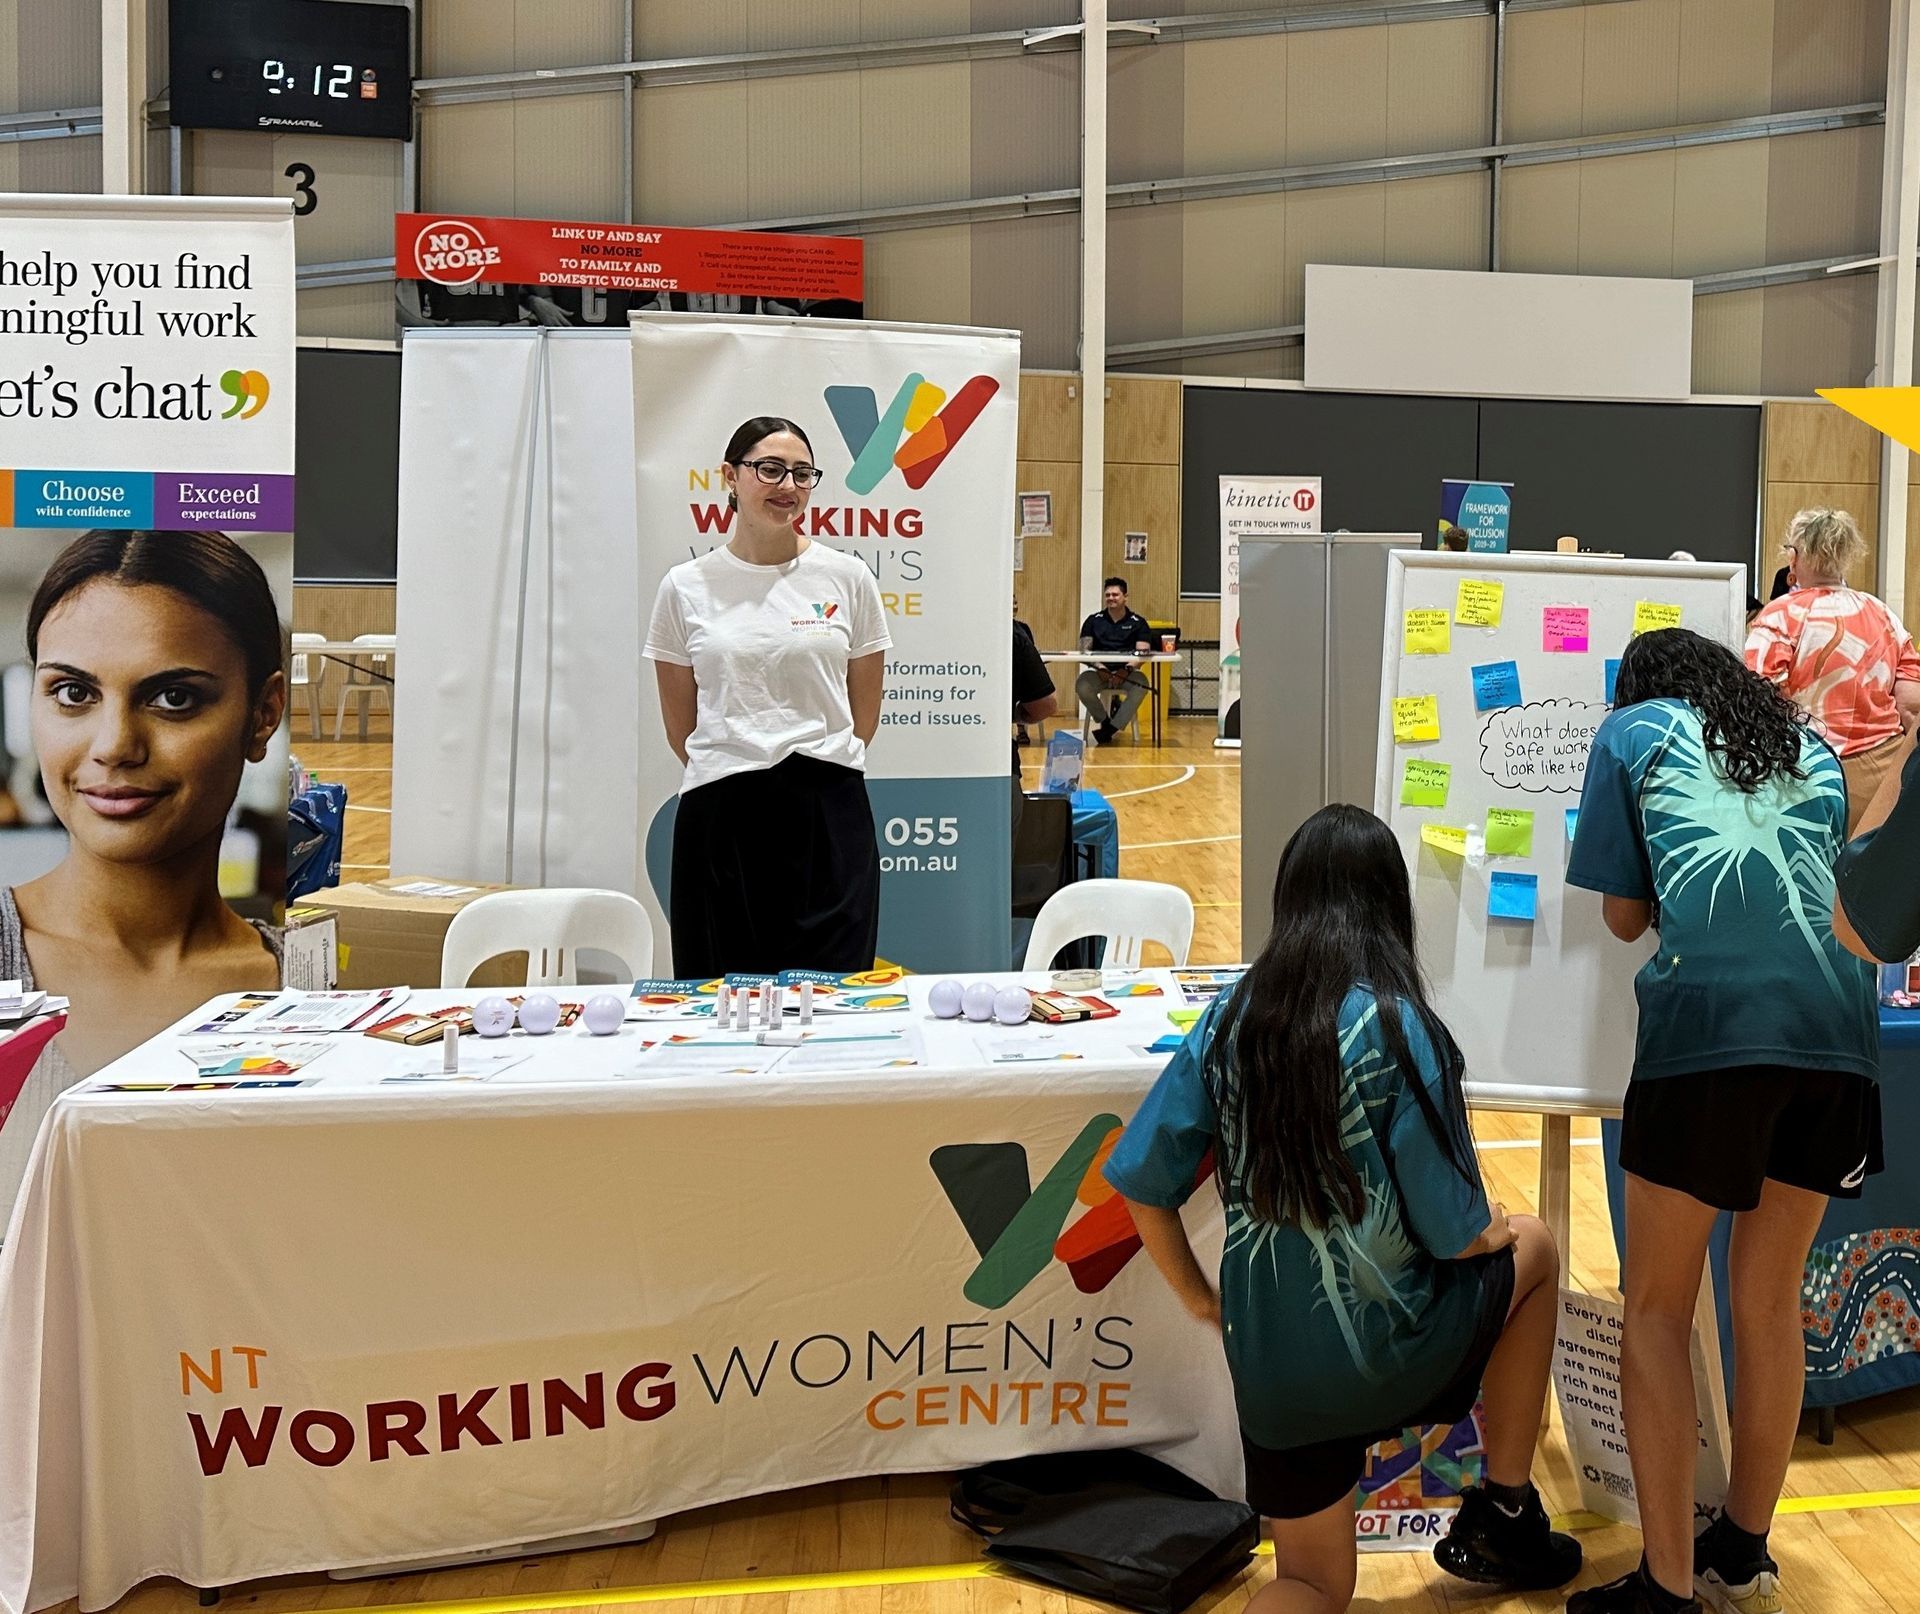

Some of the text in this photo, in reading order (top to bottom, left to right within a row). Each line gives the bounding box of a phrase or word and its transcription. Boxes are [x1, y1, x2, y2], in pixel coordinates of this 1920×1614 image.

[258, 116, 323, 127] STRAMATEL
[284, 162, 318, 216] 3
[428, 233, 469, 251] NO
[552, 227, 662, 243] LINK UP AND SAY
[423, 247, 501, 271] MORE
[580, 244, 642, 257] NO MORE
[0, 250, 252, 297] help you find
[560, 258, 661, 274] TO FAMILY AND
[539, 273, 678, 289] DOMESTIC VIOLENCE
[0, 299, 258, 345] ningful work
[0, 364, 212, 421] et's chat
[42, 480, 125, 502] Choose
[178, 482, 261, 504] Exceed
[1226, 488, 1311, 509] kinetic IT
[36, 506, 131, 518] with confidence
[181, 509, 256, 521] expectations
[1465, 503, 1508, 515] FRAMEWORK
[690, 503, 923, 538] WRKING
[1228, 520, 1242, 528] GET
[1243, 520, 1252, 528] IN
[1280, 521, 1299, 529] WITH
[1479, 515, 1494, 526] FOR
[883, 661, 986, 678] nformation,
[882, 686, 976, 703] raining for
[1413, 699, 1425, 707] and
[881, 711, 986, 725] ated issues.
[1501, 718, 1598, 739] What does
[1504, 740, 1591, 761] Safe work
[1506, 759, 1585, 777] look like to
[884, 817, 959, 846] 055
[880, 856, 957, 872] om.au
[1564, 1302, 1624, 1330] Every da
[179, 1345, 268, 1396] NT
[1564, 1357, 1620, 1383] are misu
[186, 1315, 1134, 1477] WORKING WOMEN'S
[1563, 1374, 1618, 1400] rich and
[865, 1381, 1131, 1432] CENTRE
[1566, 1392, 1615, 1417] protect
[1591, 1418, 1616, 1434] and
[1397, 1514, 1441, 1537] FOR
